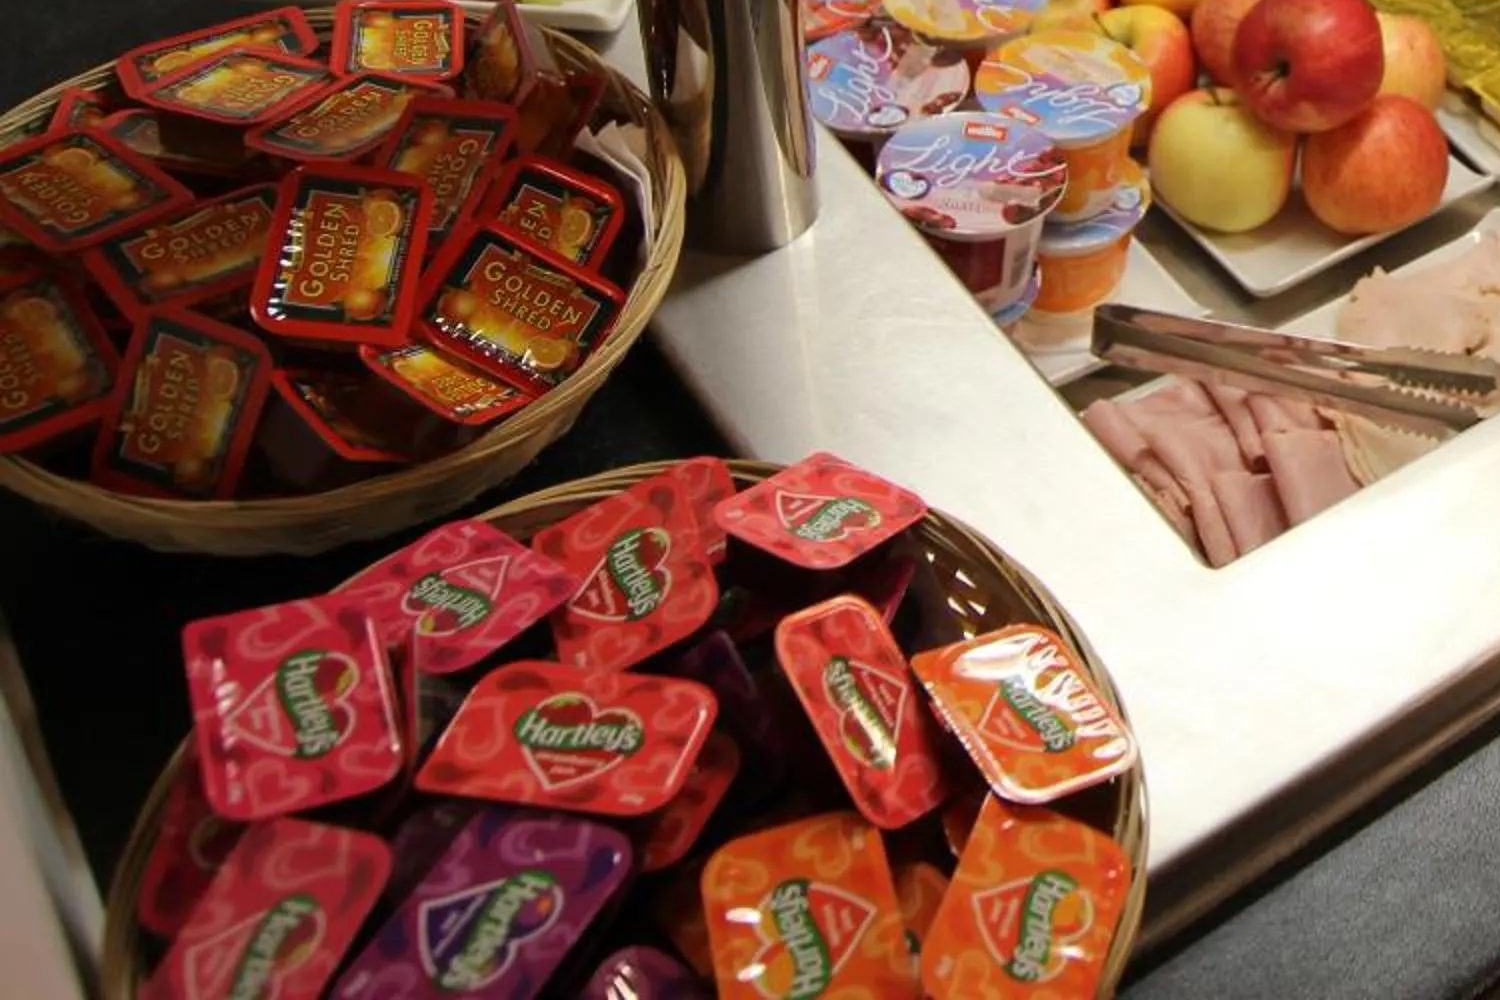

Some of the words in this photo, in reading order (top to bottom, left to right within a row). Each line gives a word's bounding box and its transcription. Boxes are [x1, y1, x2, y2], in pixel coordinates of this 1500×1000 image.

[887, 134, 1068, 189] Light
[140, 210, 262, 260] GOLDEN
[300, 202, 345, 297] GOLDEN
[329, 224, 361, 282] SHRED
[484, 261, 583, 325] GOLDEN
[492, 288, 552, 331] SHRED
[137, 350, 192, 454] GOLDEN
[518, 712, 640, 752] Hartley's
